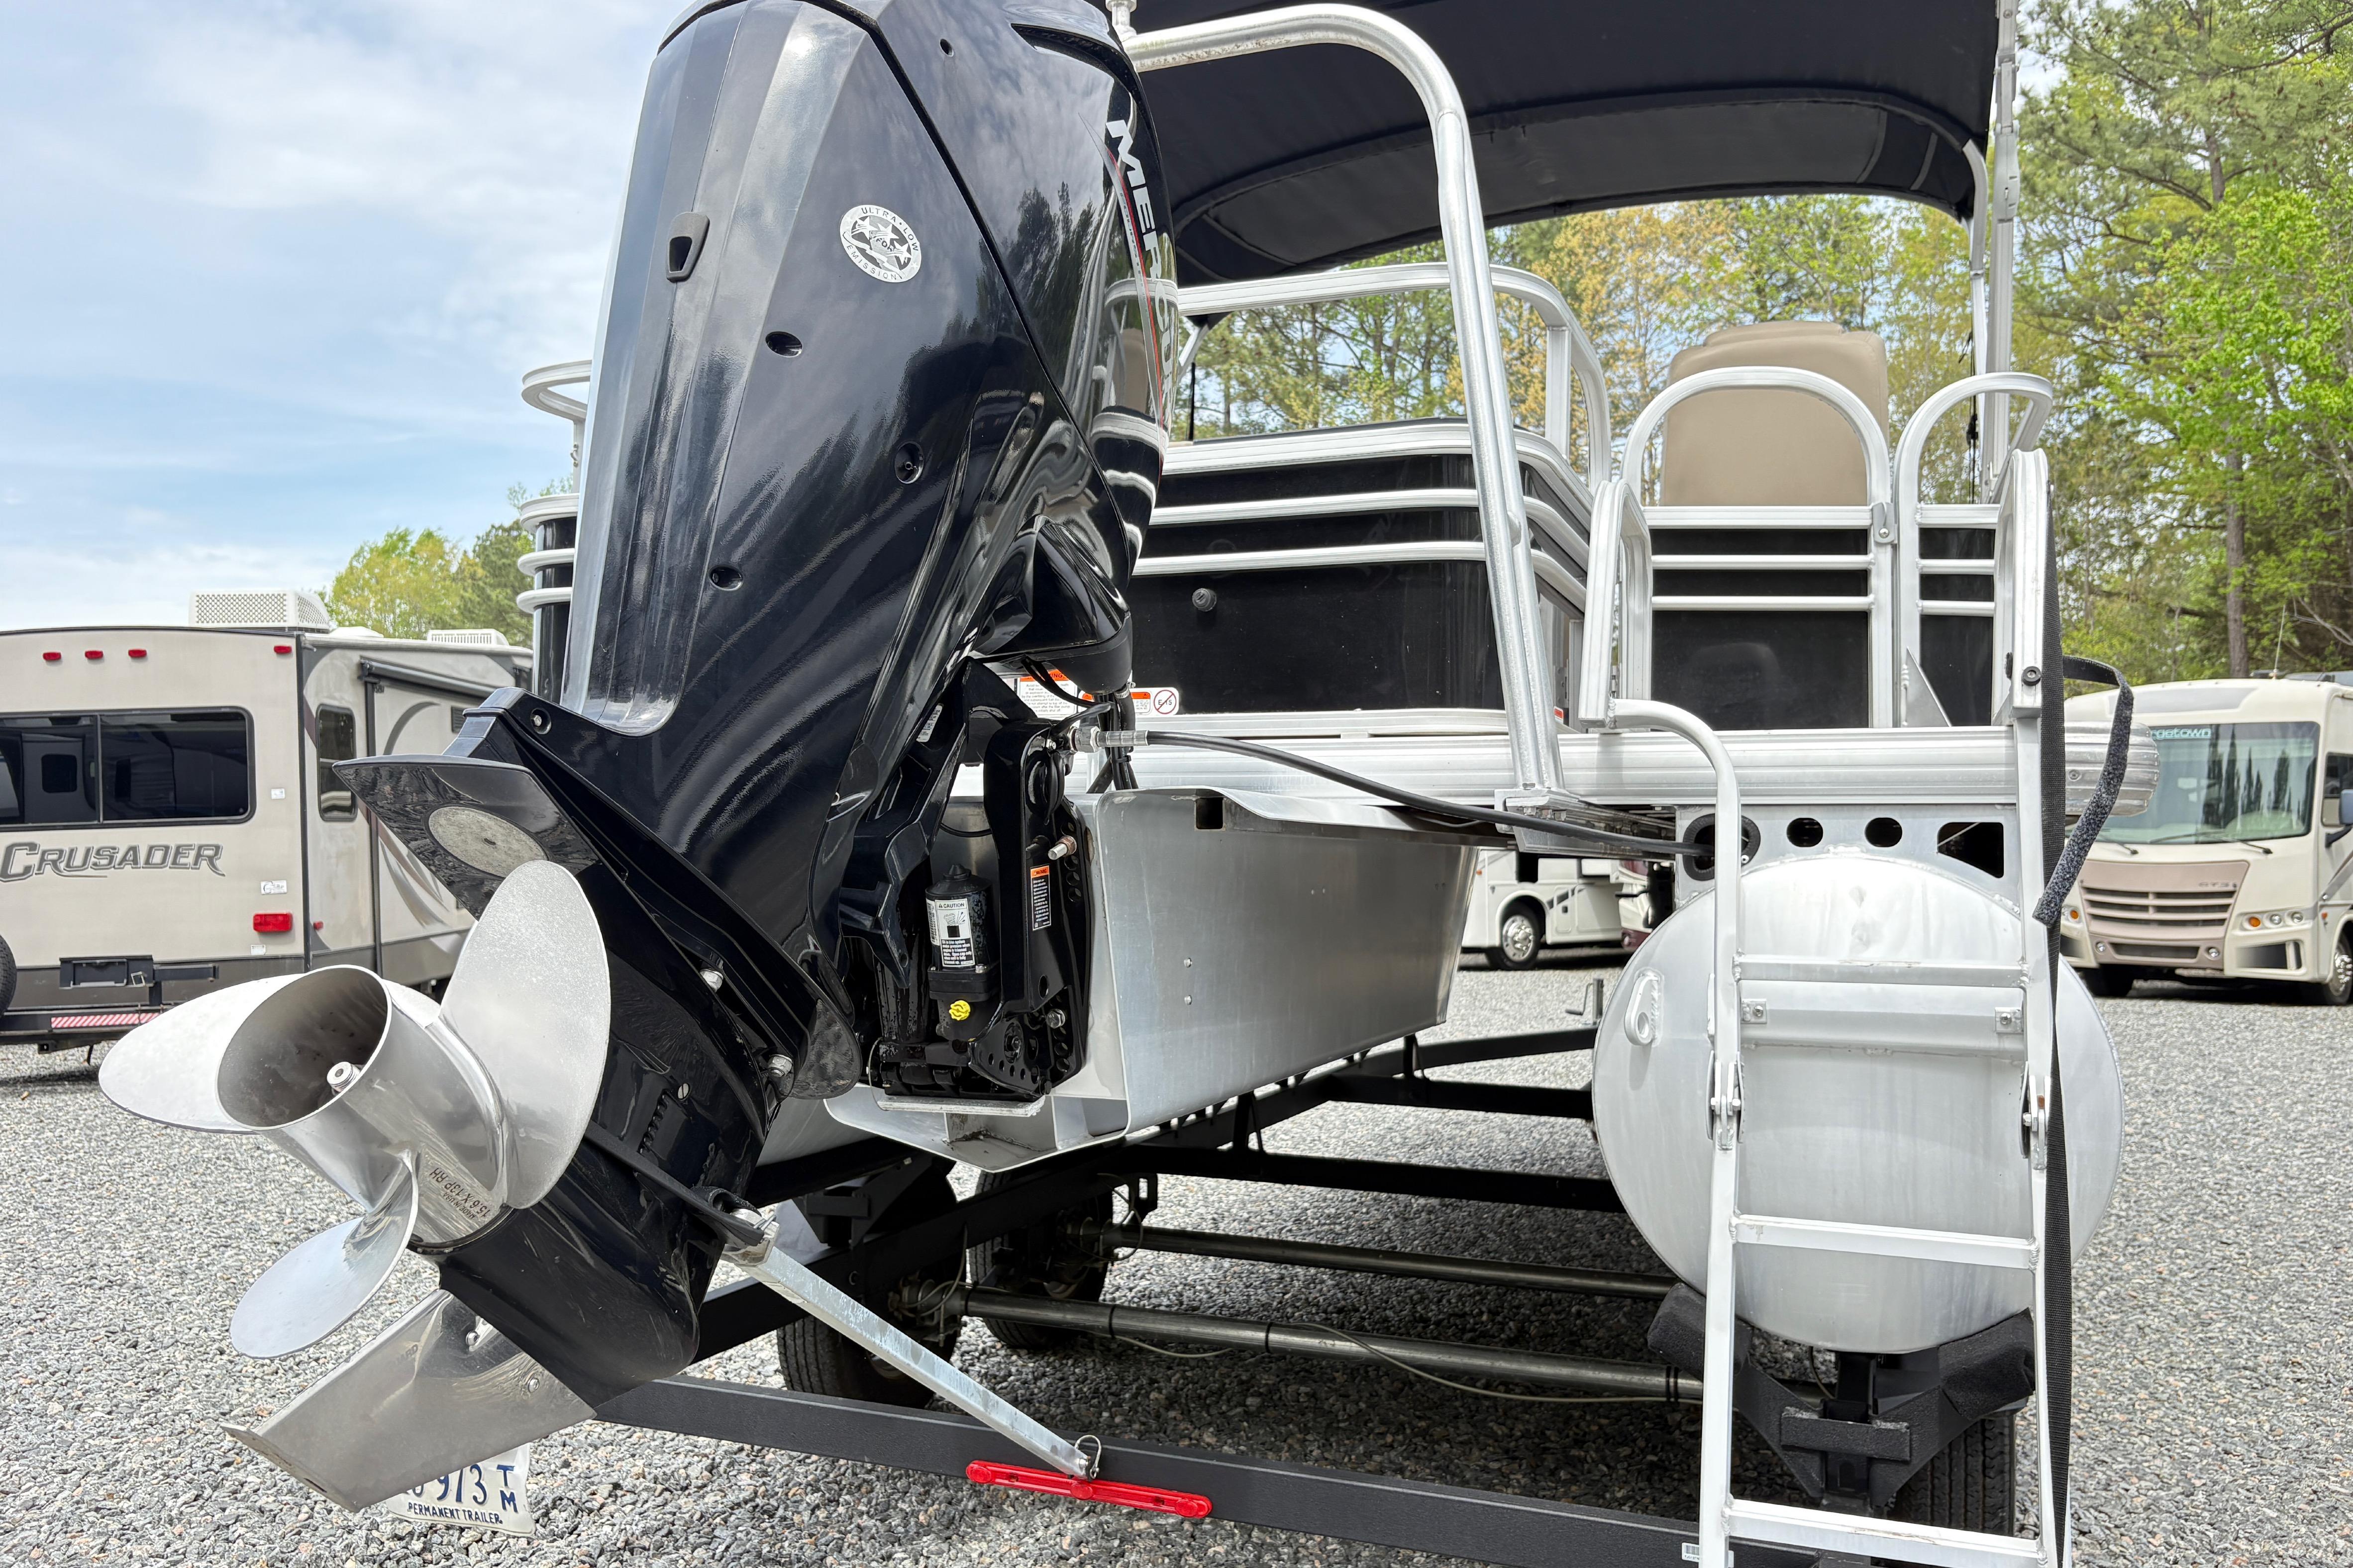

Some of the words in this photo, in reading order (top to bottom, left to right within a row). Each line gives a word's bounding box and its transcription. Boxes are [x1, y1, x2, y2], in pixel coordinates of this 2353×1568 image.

[861, 207, 896, 222] ULTRA
[903, 227, 919, 251] LOW
[847, 245, 897, 280] EMISSION
[1105, 119, 1174, 427] MERCUR
[0, 842, 225, 882] CRUSADER
[429, 1168, 448, 1182] RH
[443, 1192, 455, 1203] USA
[444, 1182, 464, 1196] 13P
[461, 1193, 474, 1203] X
[459, 1206, 476, 1219] MADE
[470, 1200, 491, 1217] 15.6
[408, 1501, 460, 1520] PERMANENT
[462, 1509, 500, 1524] TRAILER
